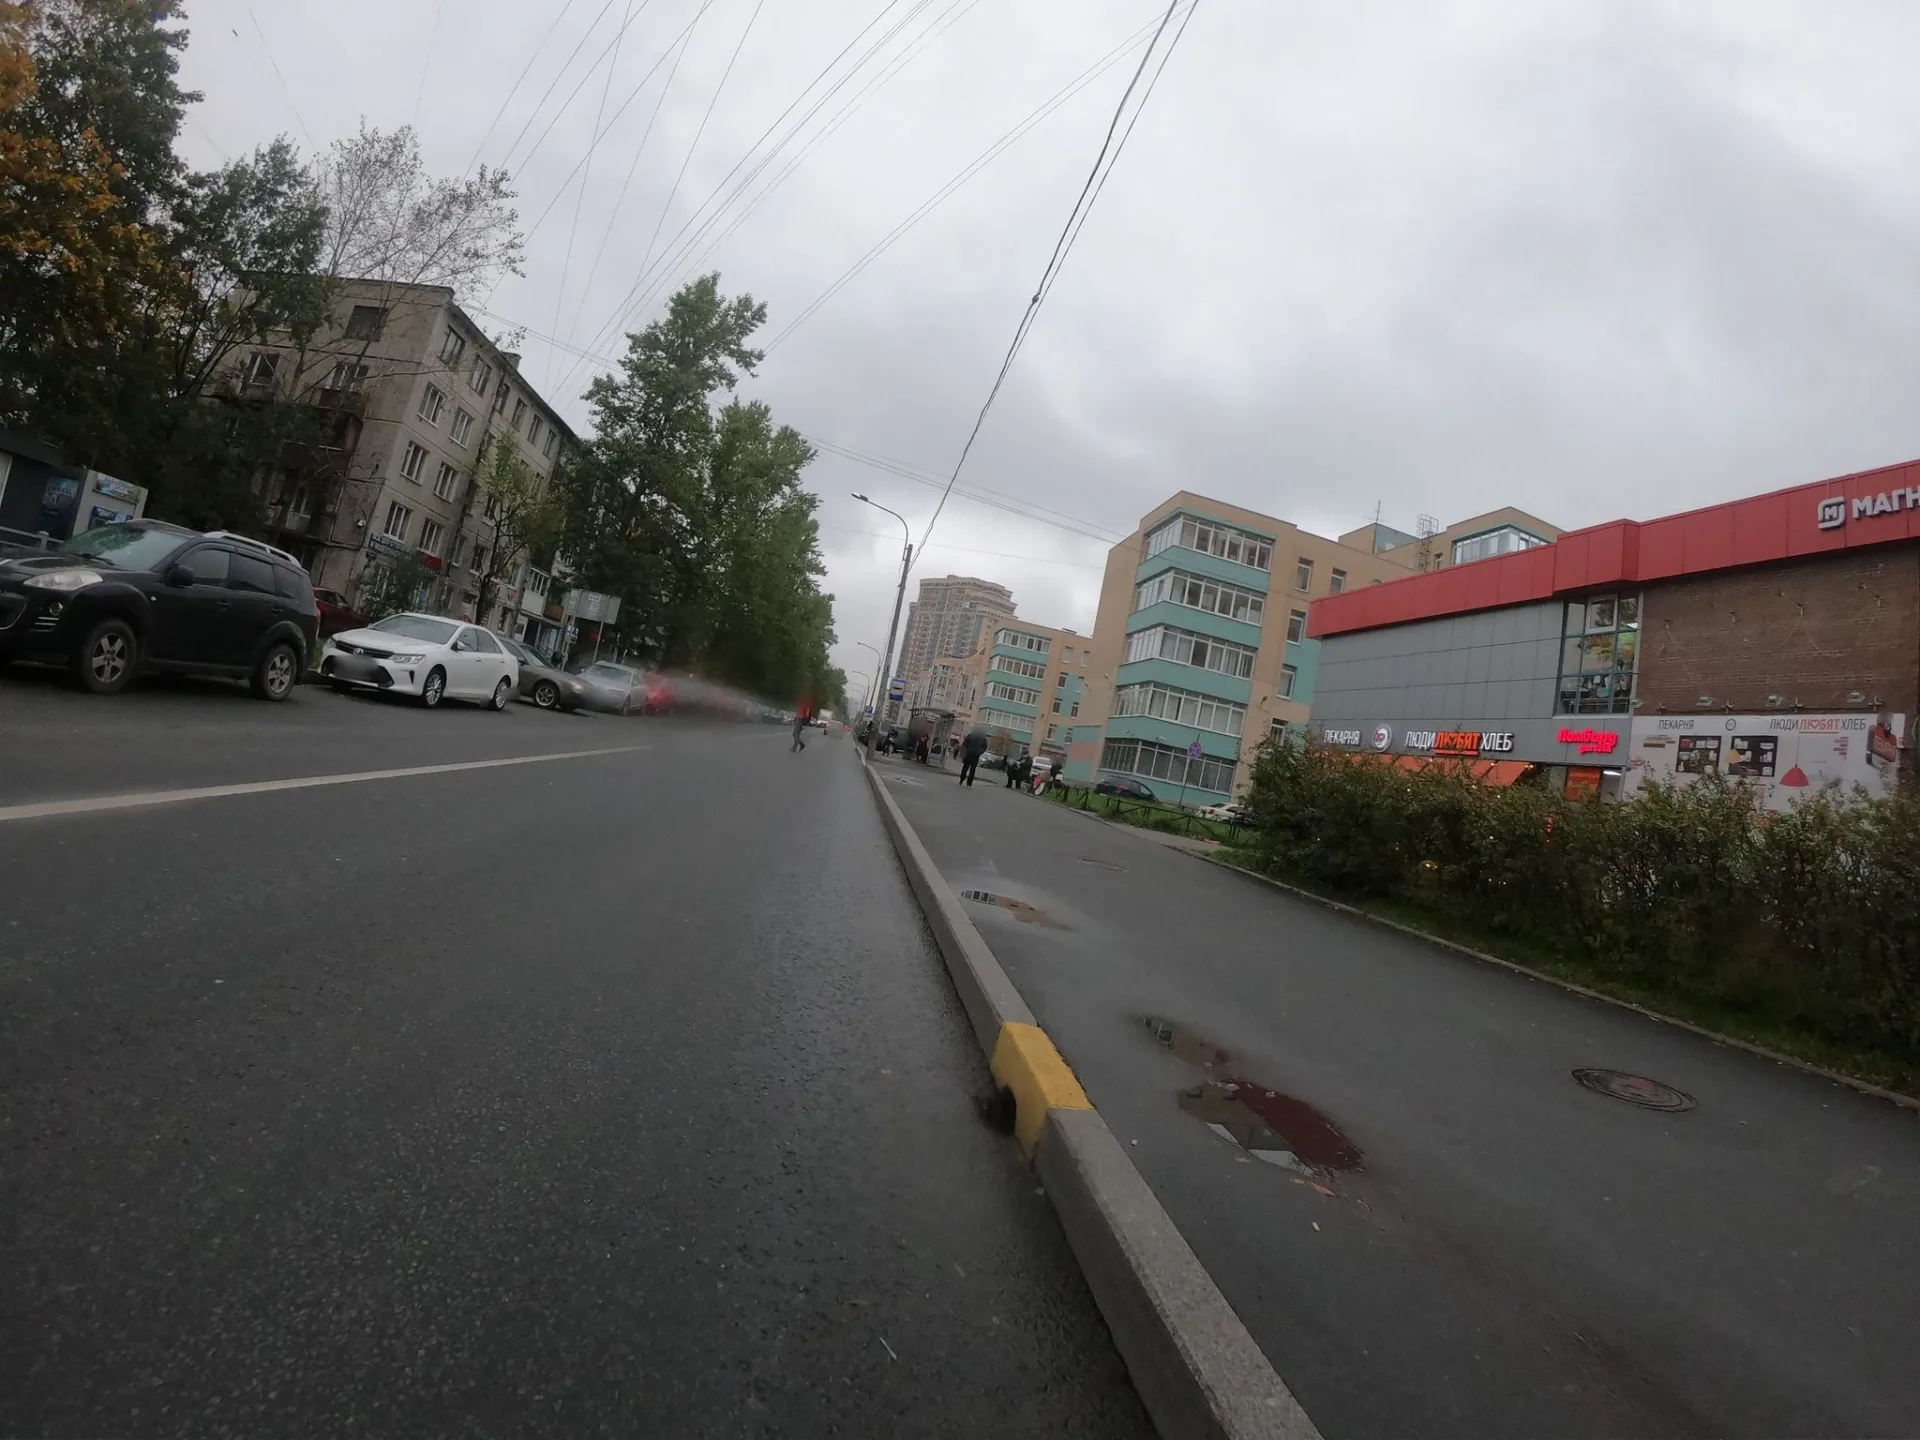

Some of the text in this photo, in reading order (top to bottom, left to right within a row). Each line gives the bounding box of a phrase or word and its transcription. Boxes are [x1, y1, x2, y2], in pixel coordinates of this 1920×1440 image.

[1658, 719, 1695, 730] ПЕКАРНЯ
[1769, 719, 1798, 731] ЛЮДИ
[1840, 718, 1867, 731] ХЛЕБ
[1323, 729, 1360, 746] ПЕКАРНЯ
[1405, 731, 1435, 750] ЛЮДИ
[1479, 733, 1513, 751] ХЛЕБ
